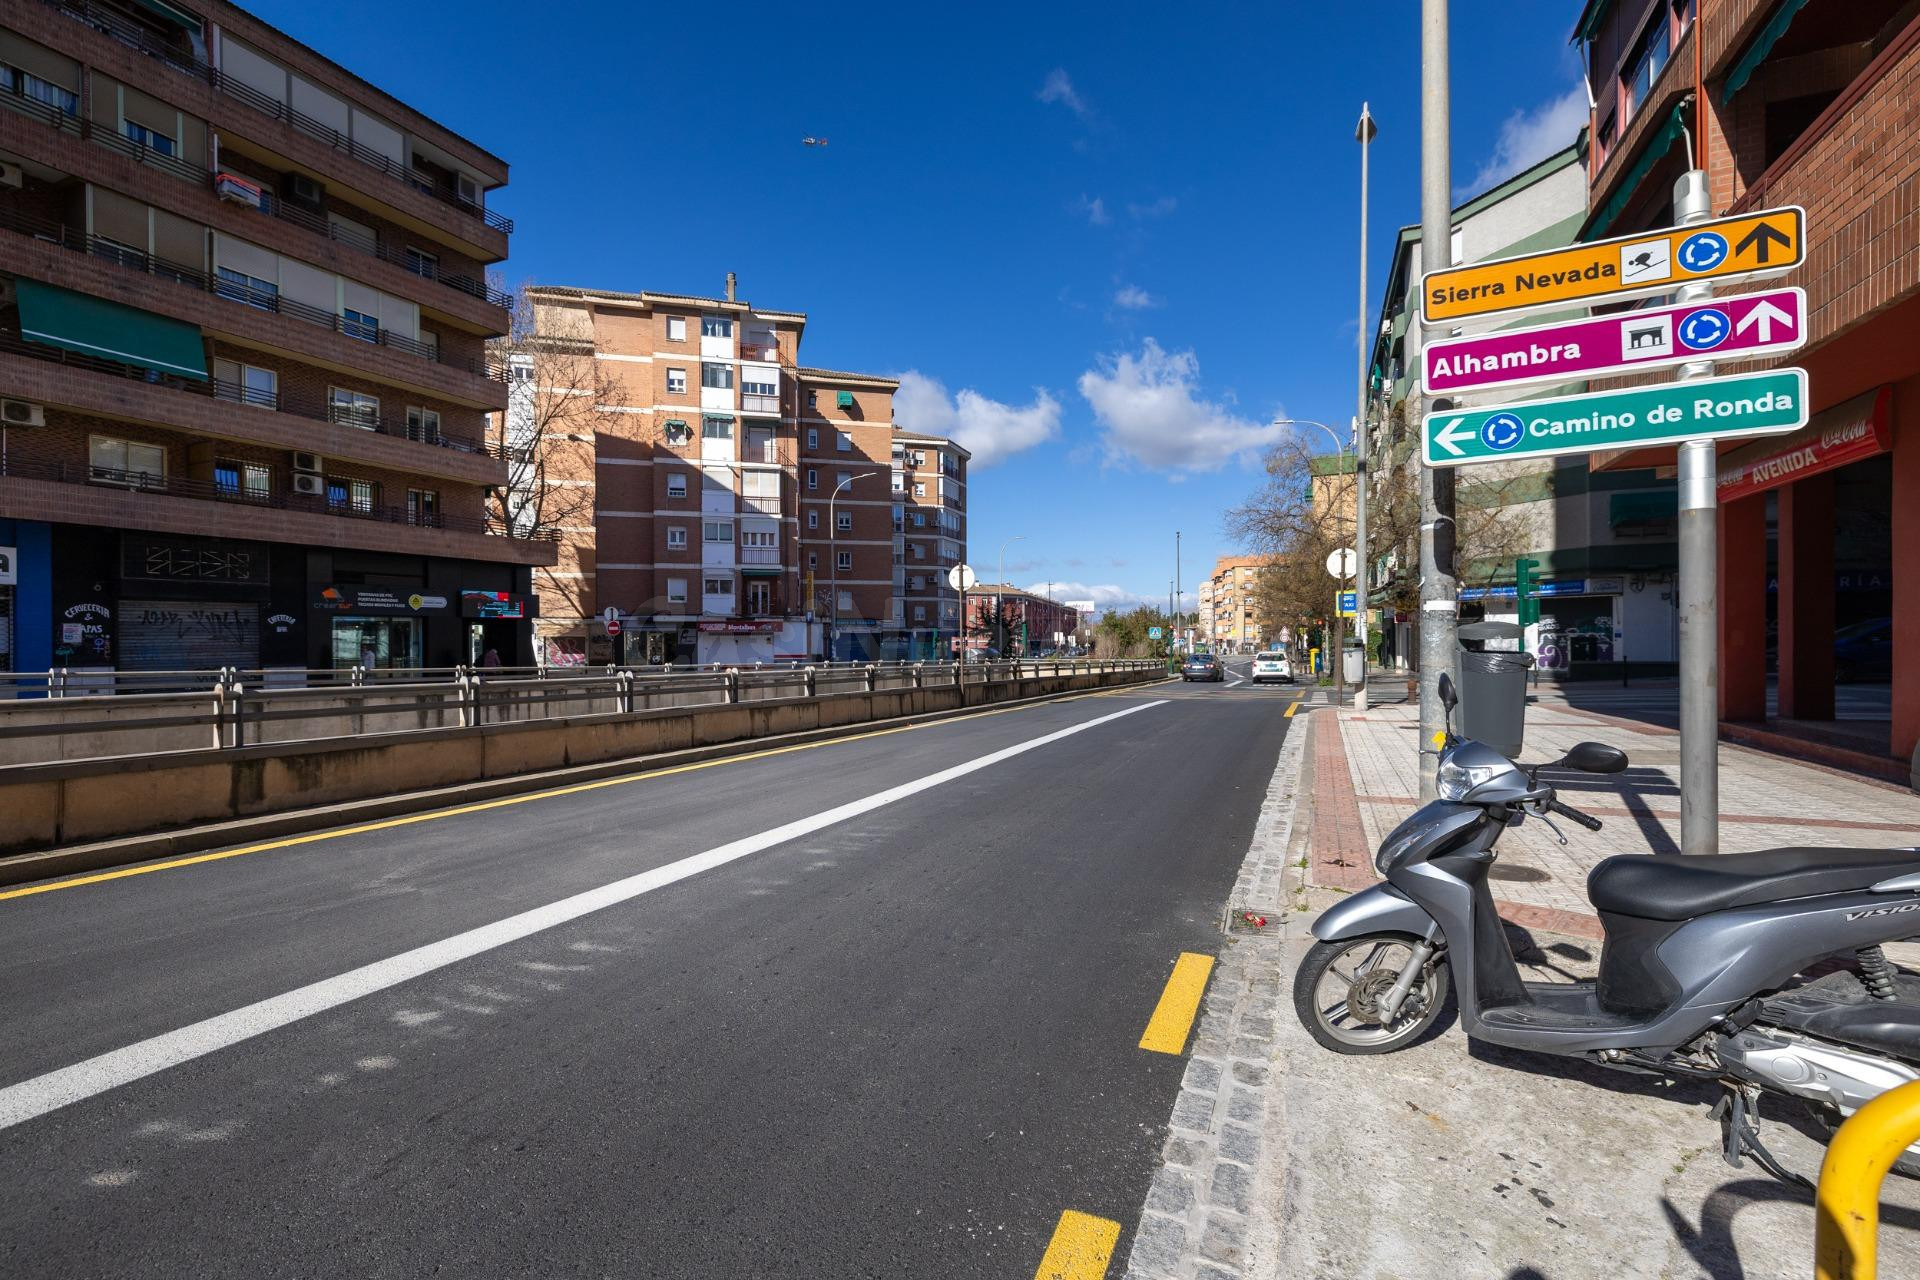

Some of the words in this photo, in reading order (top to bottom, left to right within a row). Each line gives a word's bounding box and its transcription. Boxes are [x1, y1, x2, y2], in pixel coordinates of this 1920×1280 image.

[1431, 278, 1505, 305] Sierra
[1515, 259, 1616, 292] Nevada
[1431, 339, 1582, 380] Alhambra
[1529, 411, 1636, 438] Camino
[1646, 403, 1683, 425] de
[1694, 391, 1794, 420] Ronda
[1752, 447, 1818, 485] AVENIDA
[80, 624, 104, 634] APAS
[84, 613, 94, 621] &
[1846, 904, 1920, 922] VISIO
